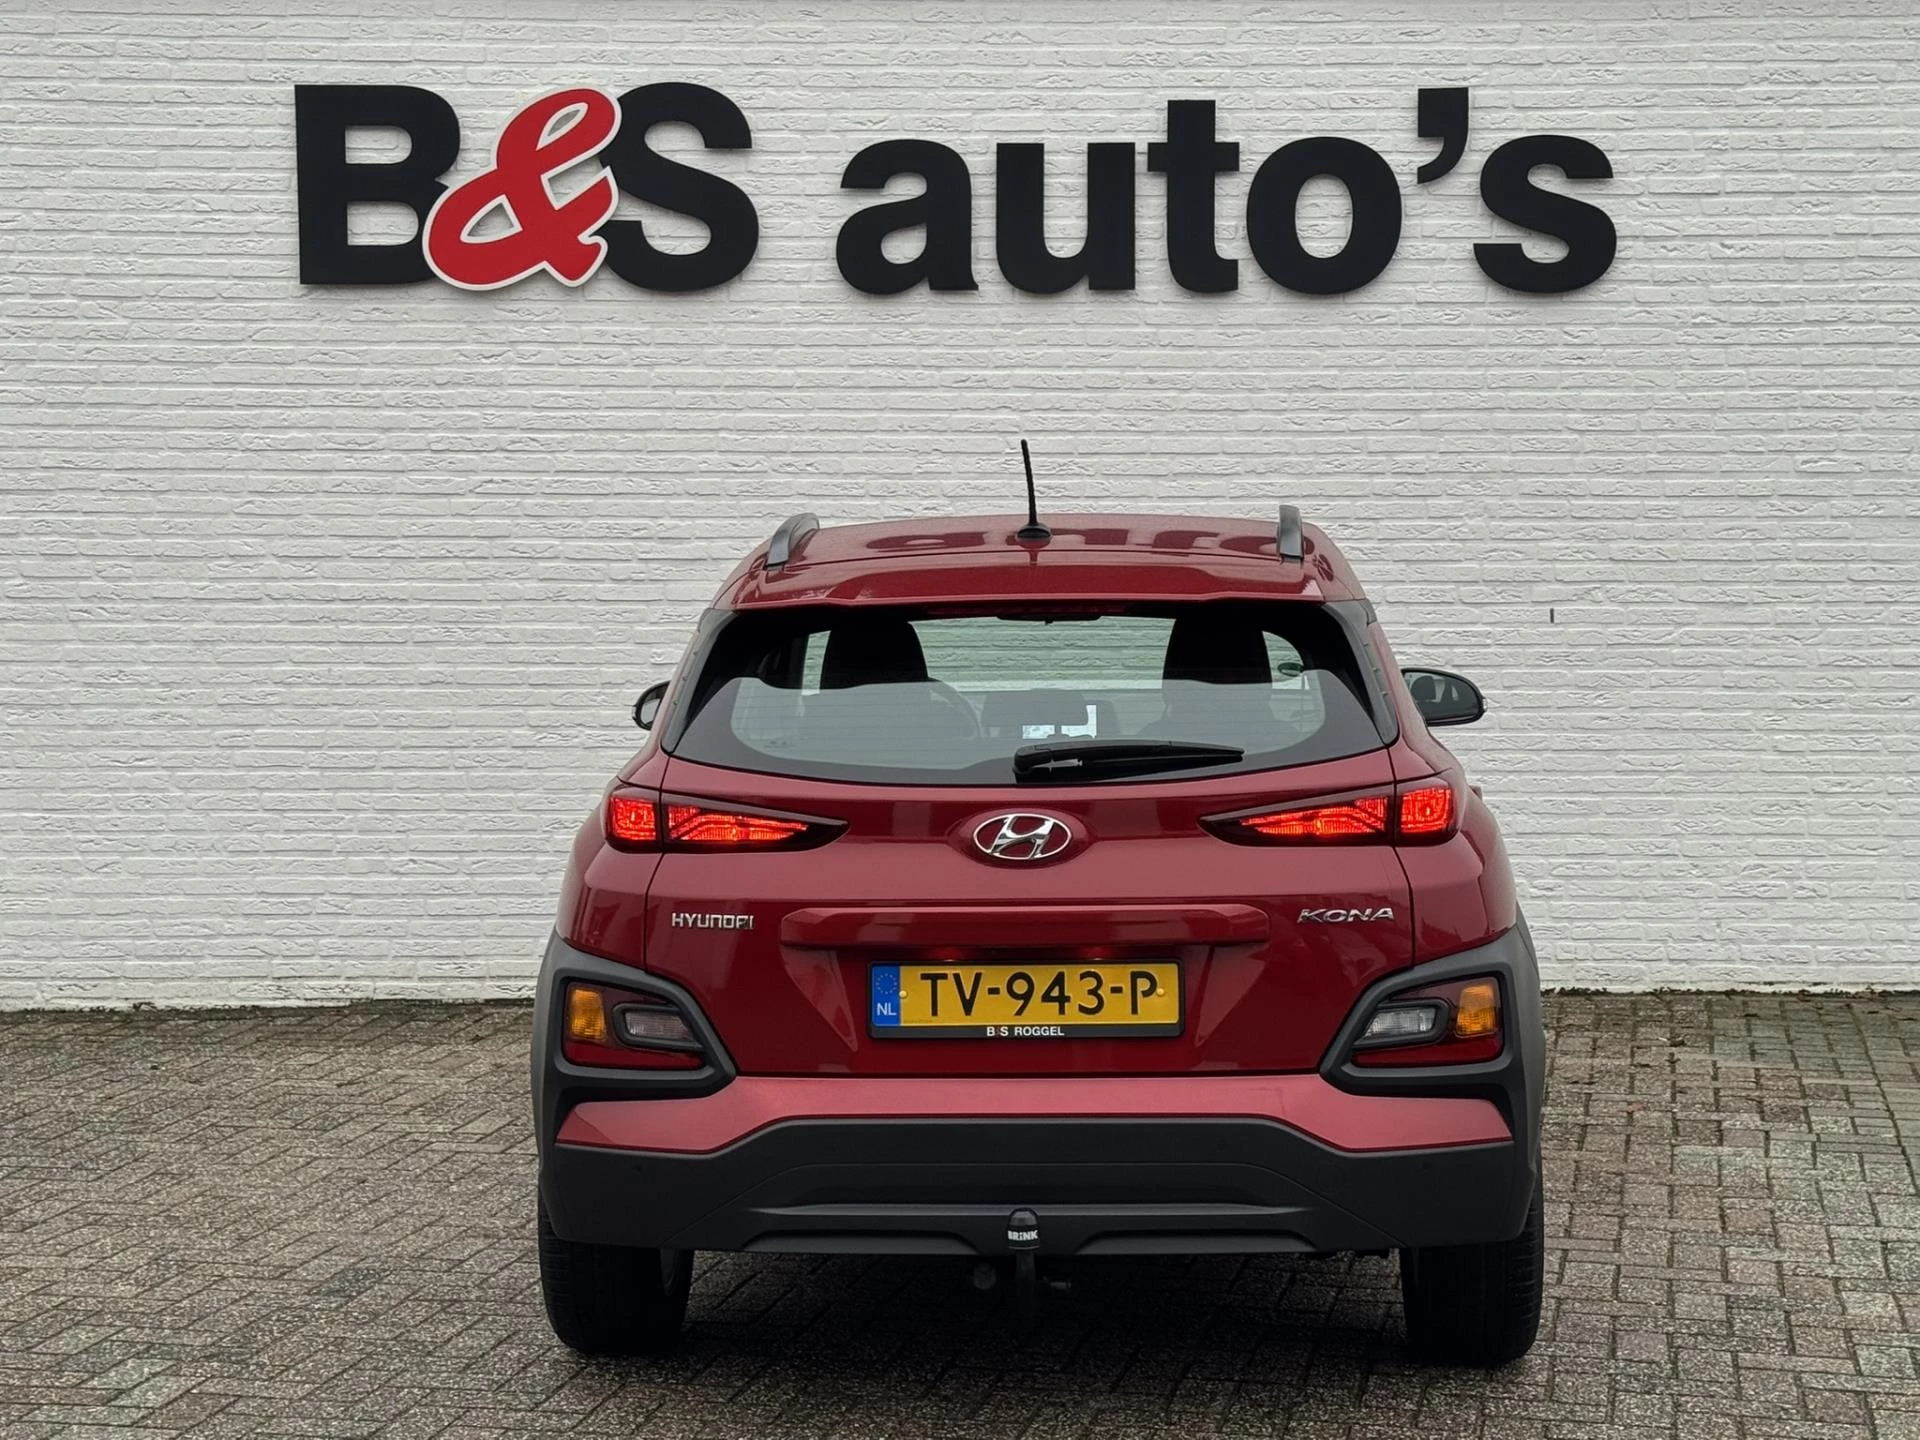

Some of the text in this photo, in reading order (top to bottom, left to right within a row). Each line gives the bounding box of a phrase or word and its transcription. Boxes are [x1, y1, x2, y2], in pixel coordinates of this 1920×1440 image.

[294, 82, 1619, 296] B&S auto's
[671, 912, 754, 929] HYUNDAI
[1296, 907, 1395, 923] KONA
[920, 970, 1158, 1017] TV-943-P
[877, 1002, 896, 1016] NL
[1014, 1026, 1064, 1036] ROGGEL
